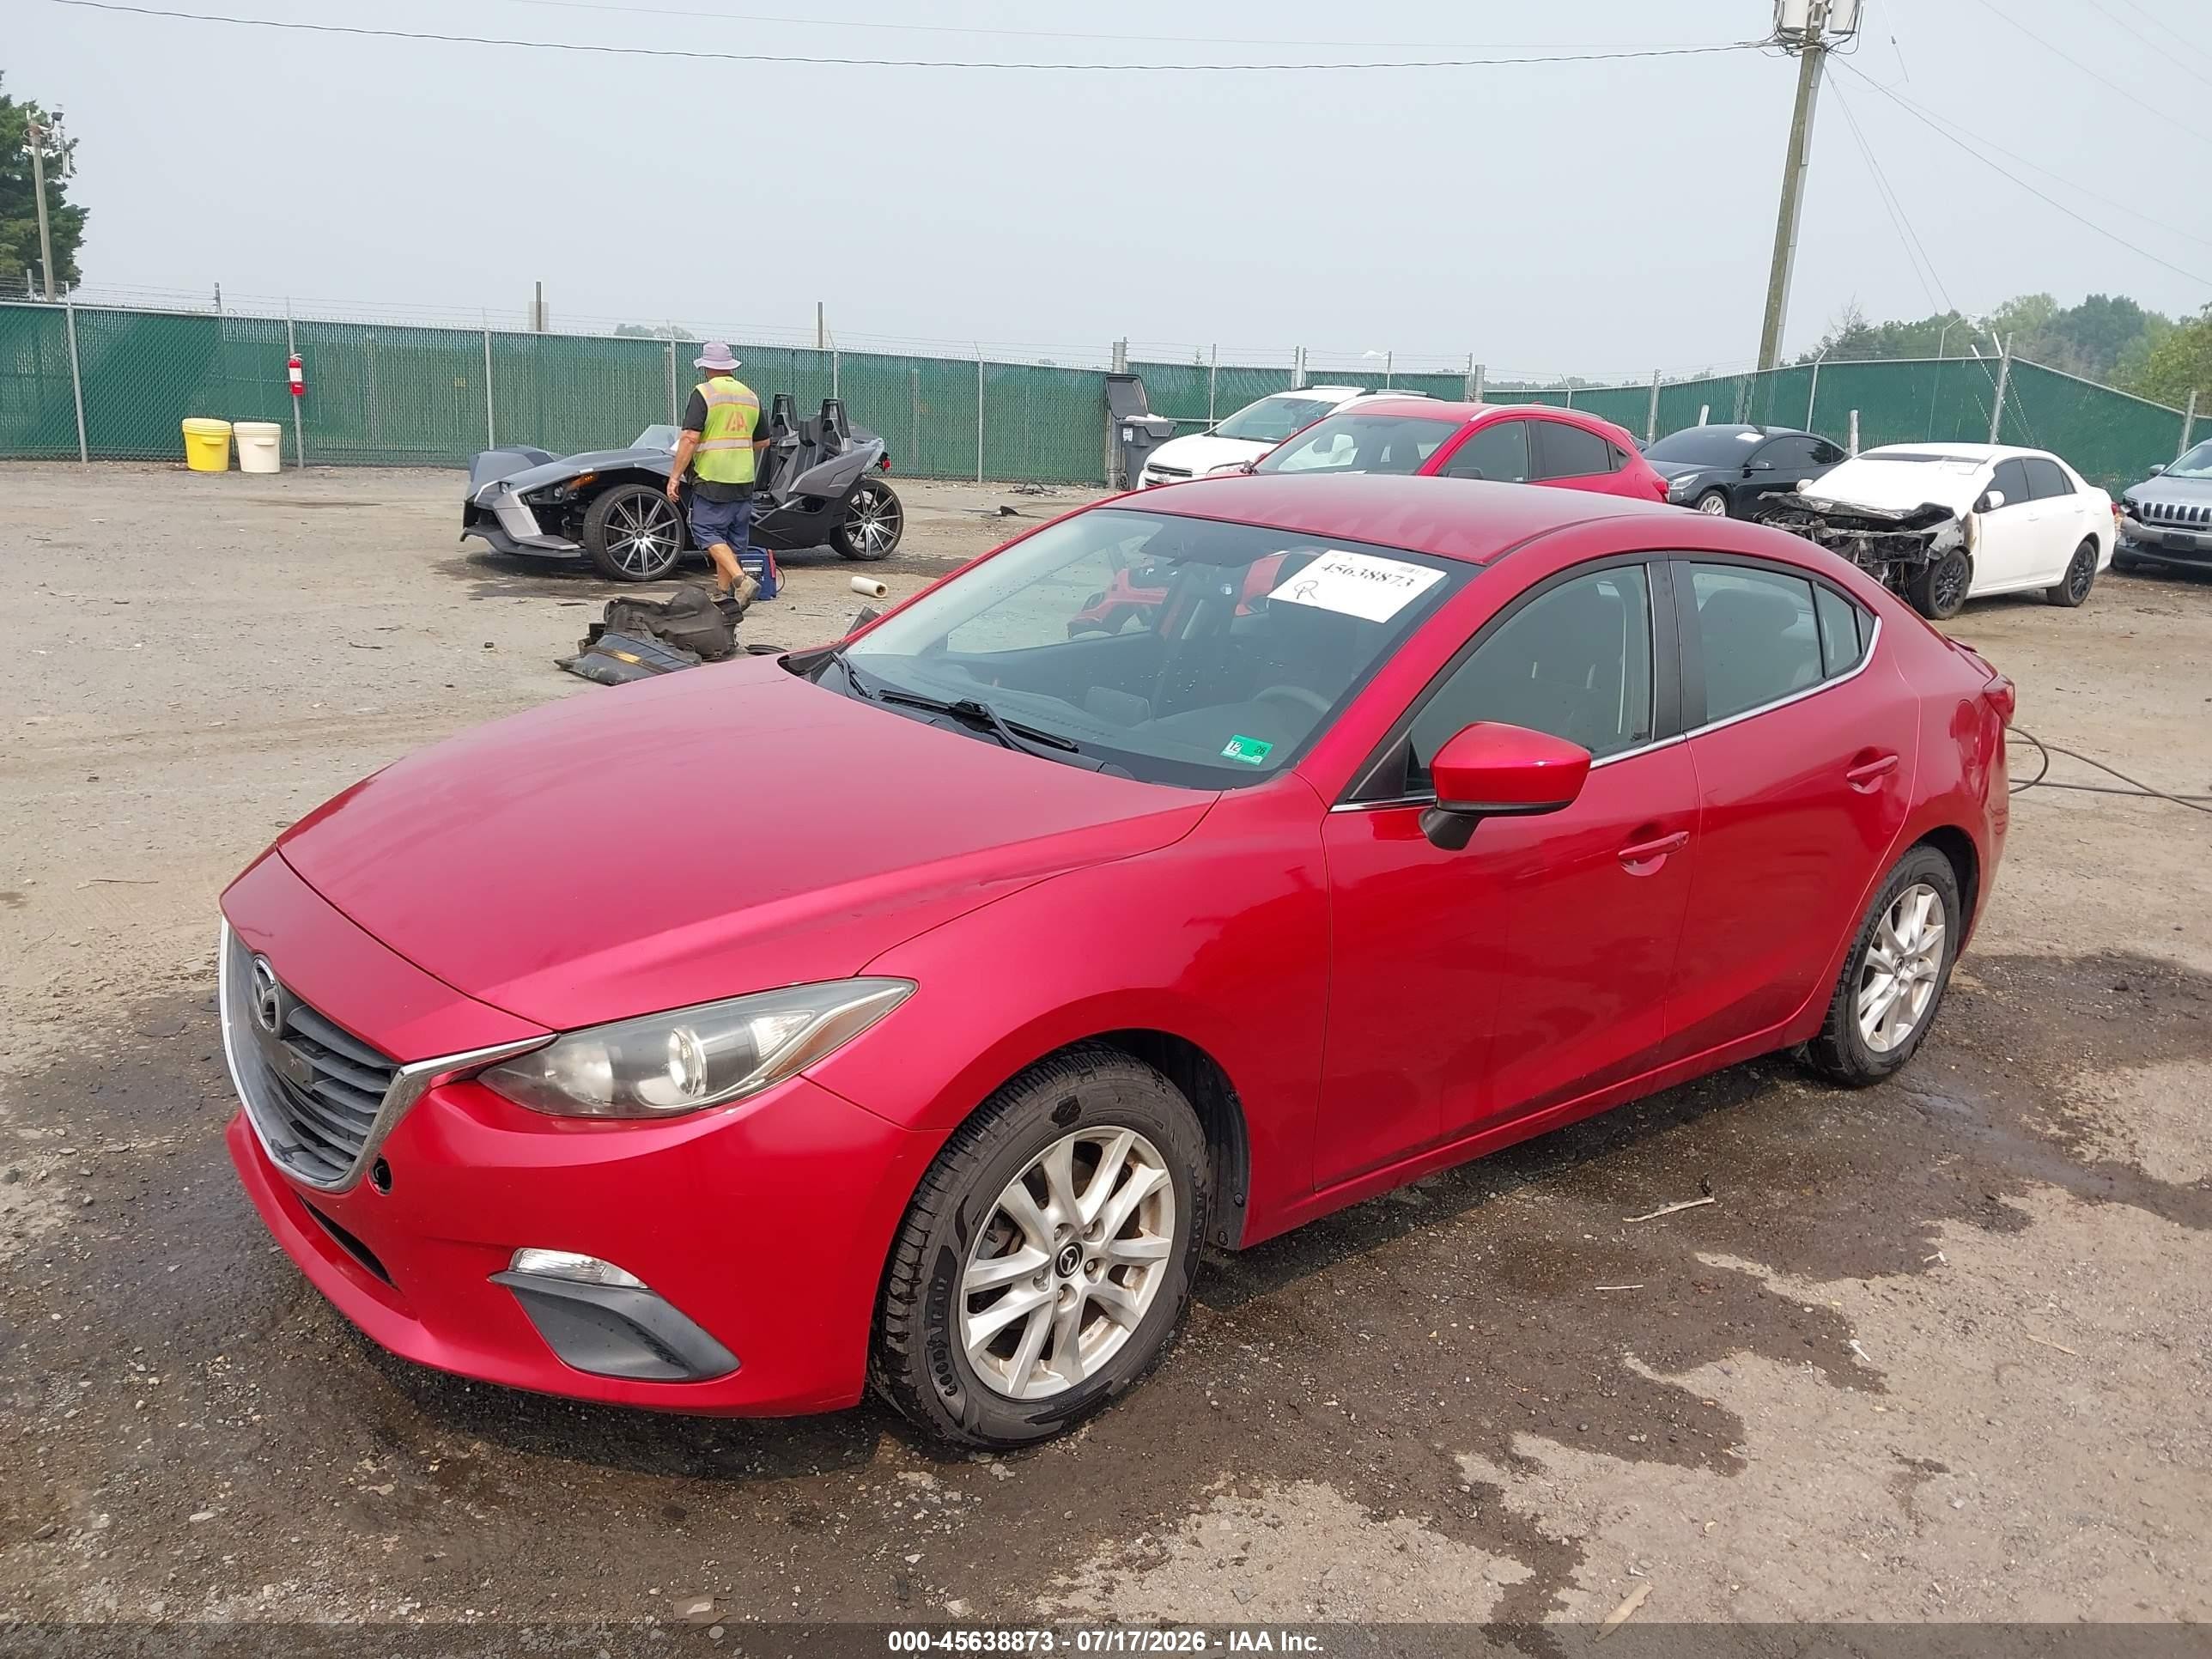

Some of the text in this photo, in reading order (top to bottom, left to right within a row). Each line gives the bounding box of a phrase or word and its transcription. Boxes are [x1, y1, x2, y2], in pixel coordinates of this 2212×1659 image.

[1322, 562, 1415, 588] 45638873
[1229, 741, 1243, 752] 12
[1254, 745, 1267, 755] 26
